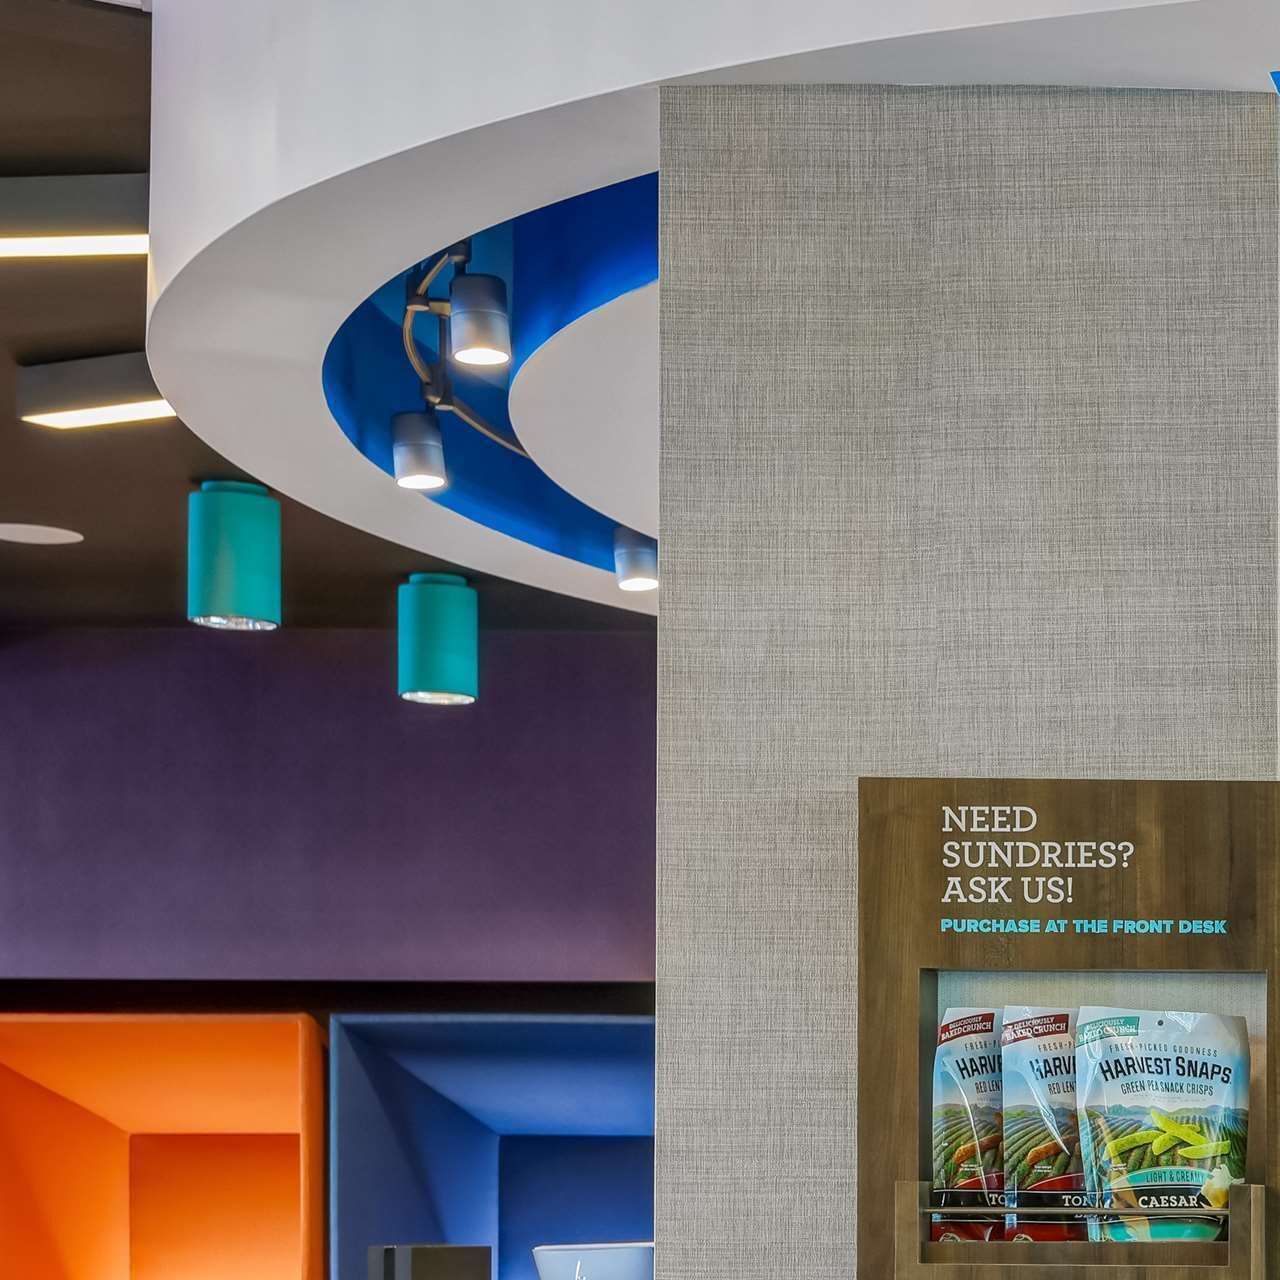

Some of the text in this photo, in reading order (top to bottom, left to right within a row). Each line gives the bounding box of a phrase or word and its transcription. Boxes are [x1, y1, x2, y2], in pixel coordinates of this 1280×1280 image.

[942, 807, 1037, 832] NEED
[942, 842, 1133, 868] SUNDRIES?
[942, 877, 1073, 903] ASK US!
[941, 919, 1226, 934] PURCHASE AT THE FRONT DESK
[963, 1022, 991, 1032] CRUNCH
[1033, 1023, 1066, 1034] CRUNCH
[1173, 1045, 1218, 1057] GOODNESS
[1099, 1056, 1171, 1081] HARVEST
[1121, 1082, 1145, 1095] GREEN
[1160, 1082, 1184, 1093] SNACK
[1187, 1083, 1213, 1095] CRISPS
[1138, 1195, 1198, 1208] CAESAR
